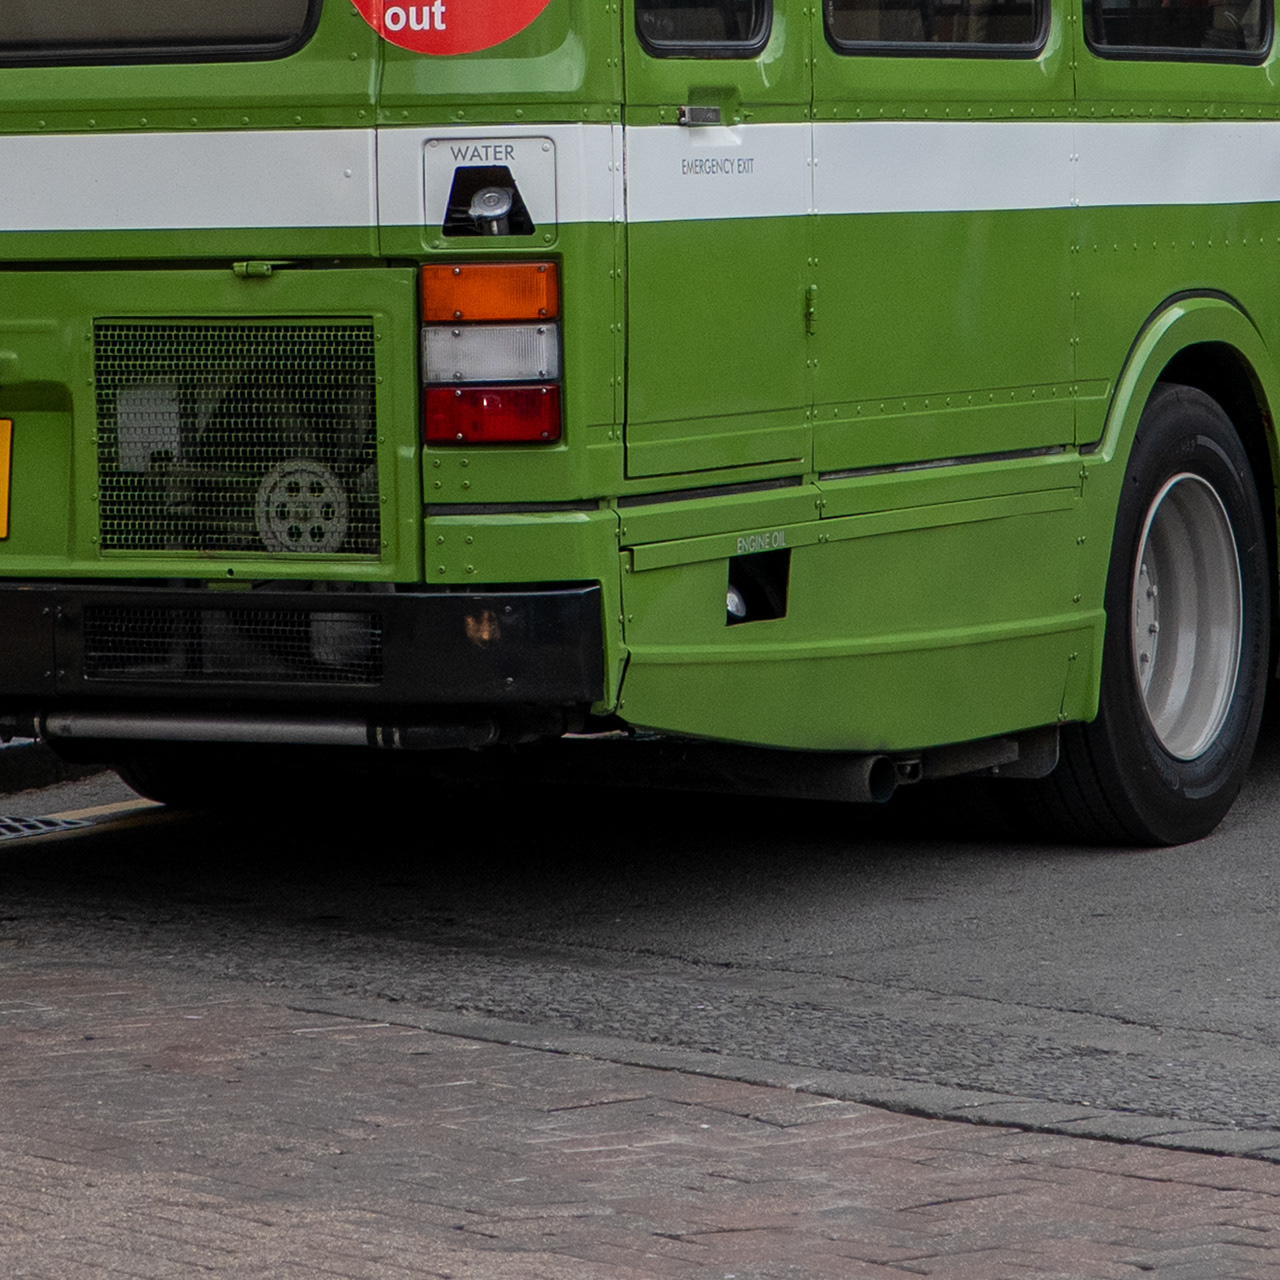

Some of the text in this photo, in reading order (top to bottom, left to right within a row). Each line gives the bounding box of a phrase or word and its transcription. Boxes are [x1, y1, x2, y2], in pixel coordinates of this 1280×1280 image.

[450, 144, 516, 162] WATER
[681, 158, 755, 175] EMERGENCY EXIT
[736, 530, 786, 553] ENGINE OIL
